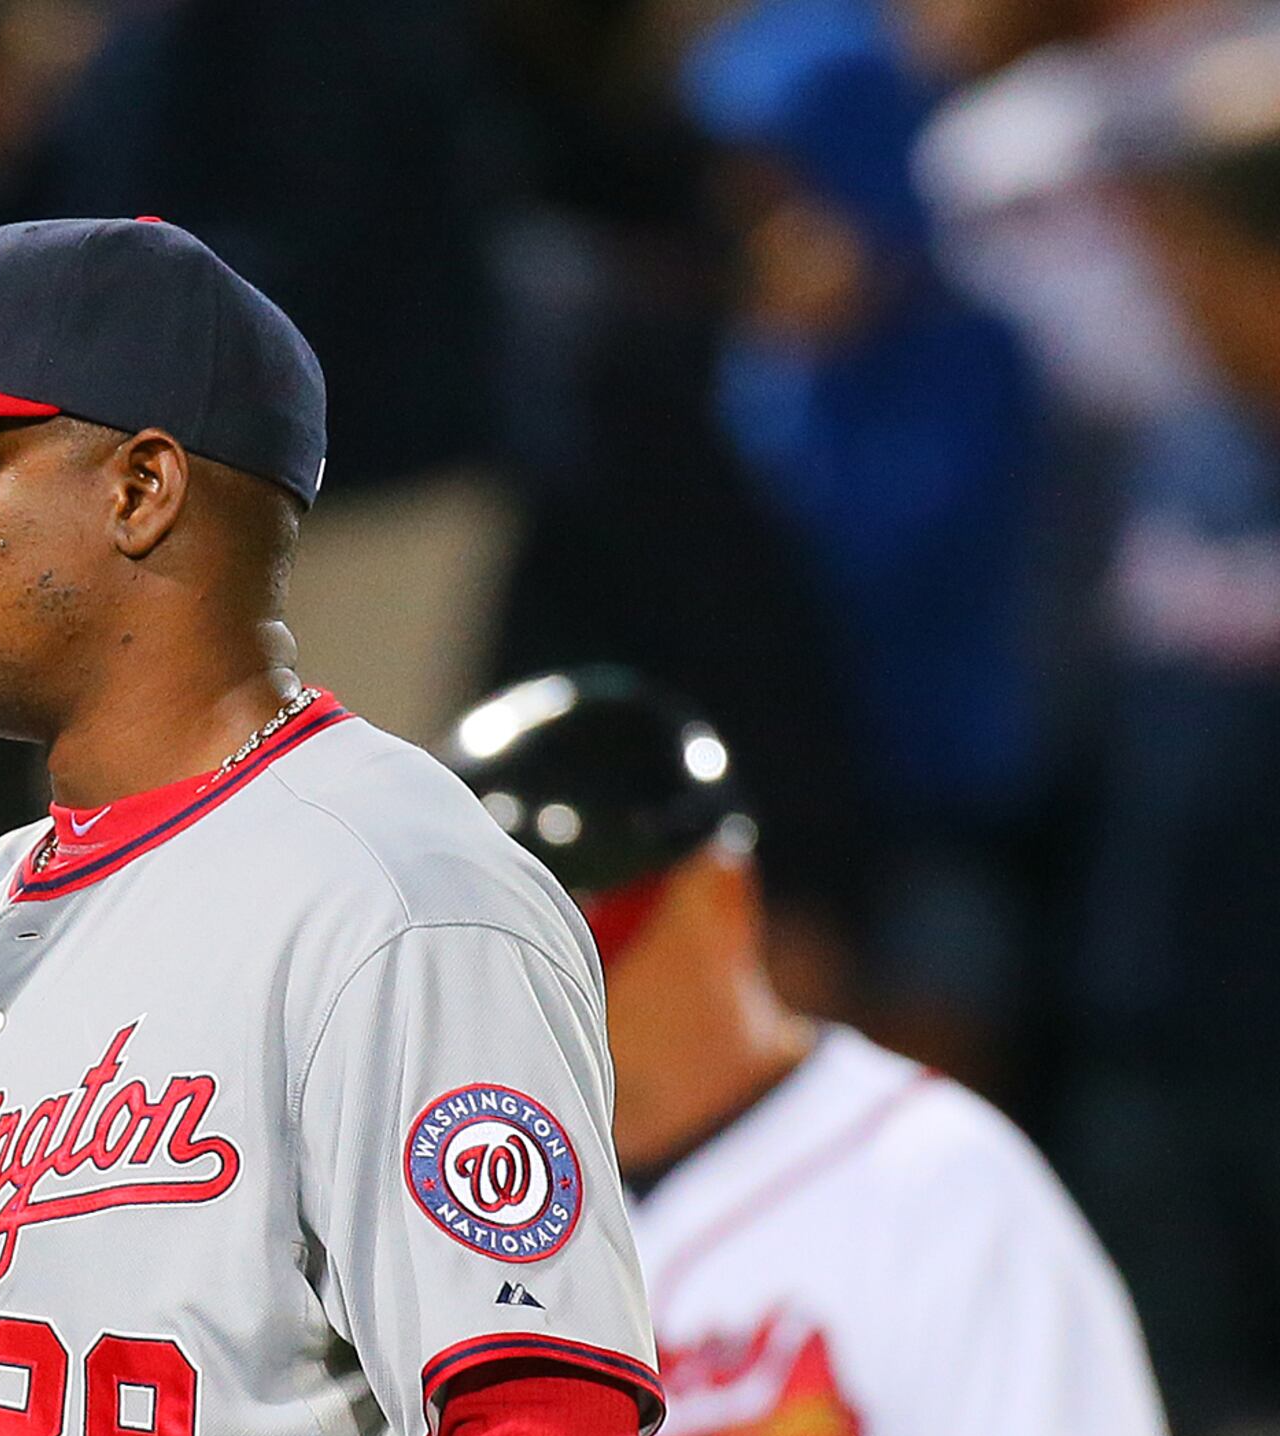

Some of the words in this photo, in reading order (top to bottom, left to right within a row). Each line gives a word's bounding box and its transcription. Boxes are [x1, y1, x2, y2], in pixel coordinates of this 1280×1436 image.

[415, 1091, 567, 1159] WASHINGTON
[455, 1134, 532, 1213] W
[436, 1203, 569, 1253] NATIONALS
